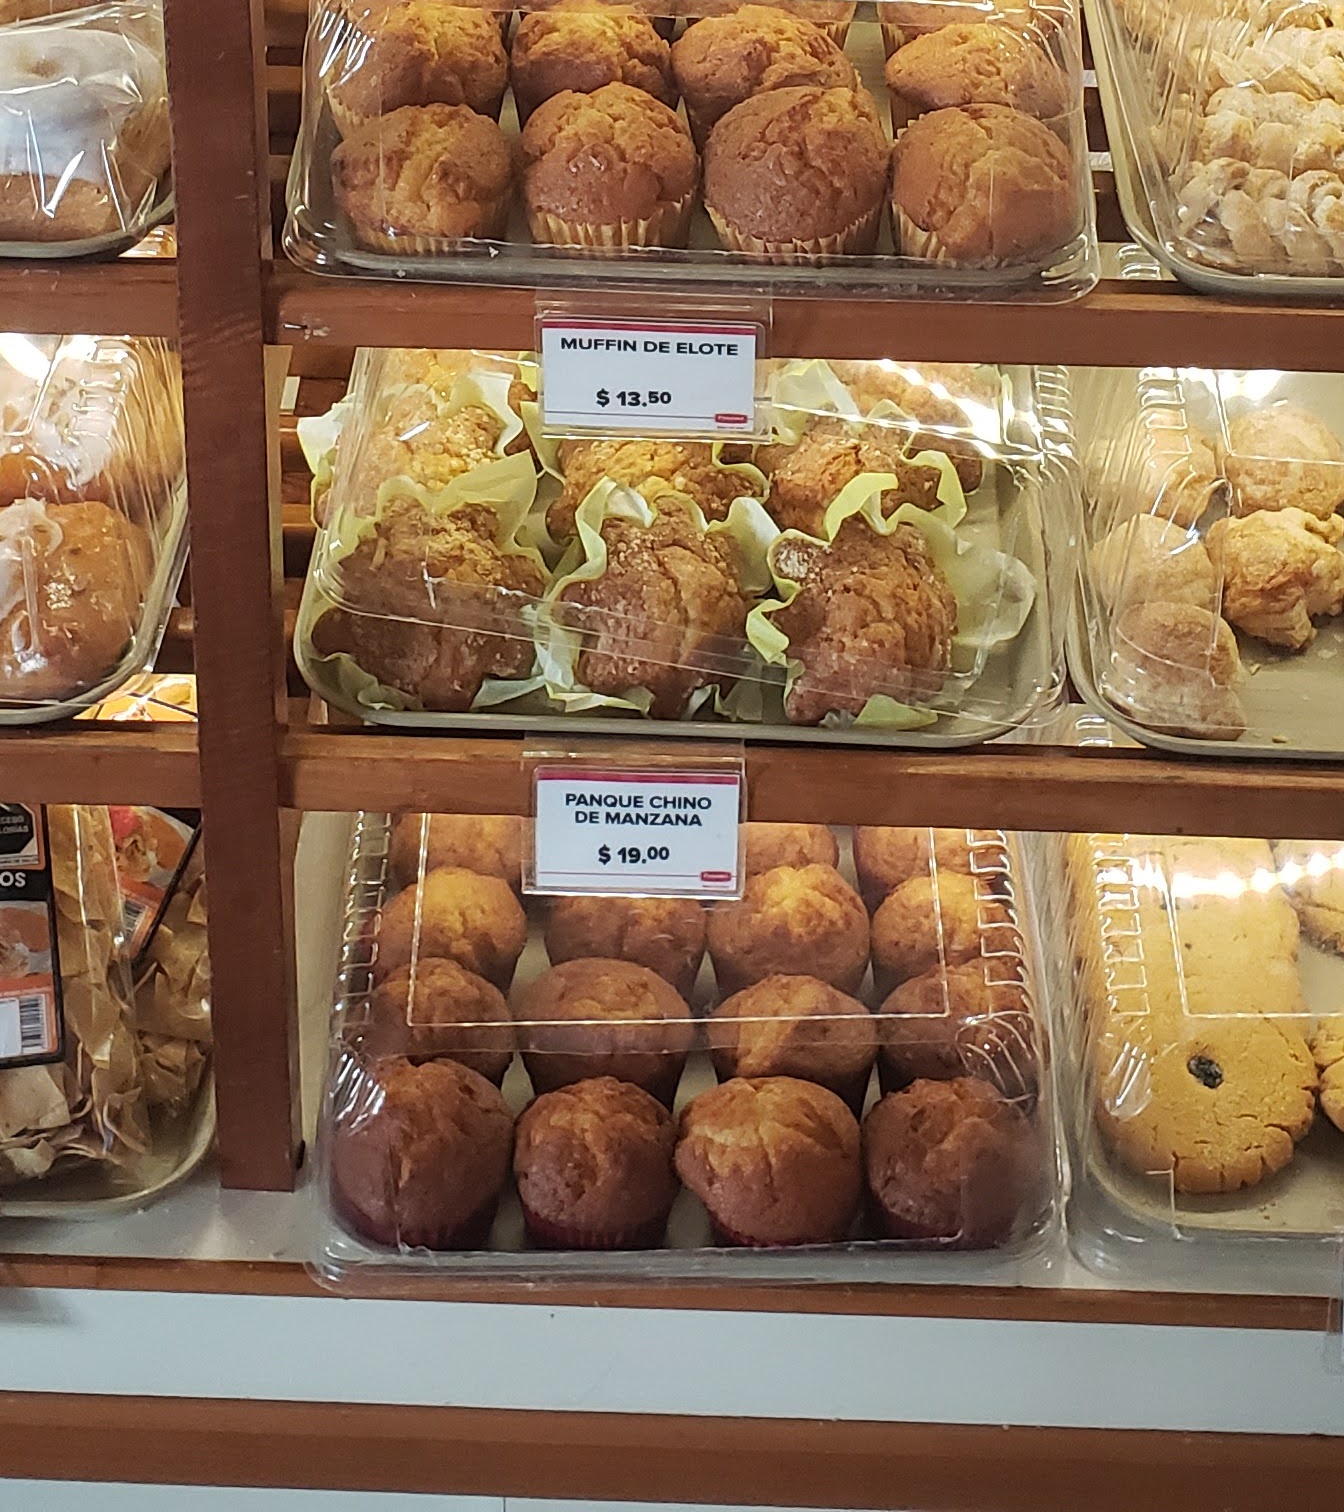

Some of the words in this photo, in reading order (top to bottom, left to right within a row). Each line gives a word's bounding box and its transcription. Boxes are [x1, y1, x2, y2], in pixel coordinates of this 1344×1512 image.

[560, 337, 637, 352] MUFFIN
[643, 340, 671, 354] DE
[676, 342, 739, 356] ELOTE
[596, 388, 610, 407] $
[616, 390, 672, 407] 13.50
[565, 793, 644, 809] PANQUE
[649, 796, 712, 810] CHINO
[574, 811, 600, 824] DE
[605, 812, 702, 826] MANZANA
[598, 843, 611, 865] $
[617, 846, 670, 864] 19.00
